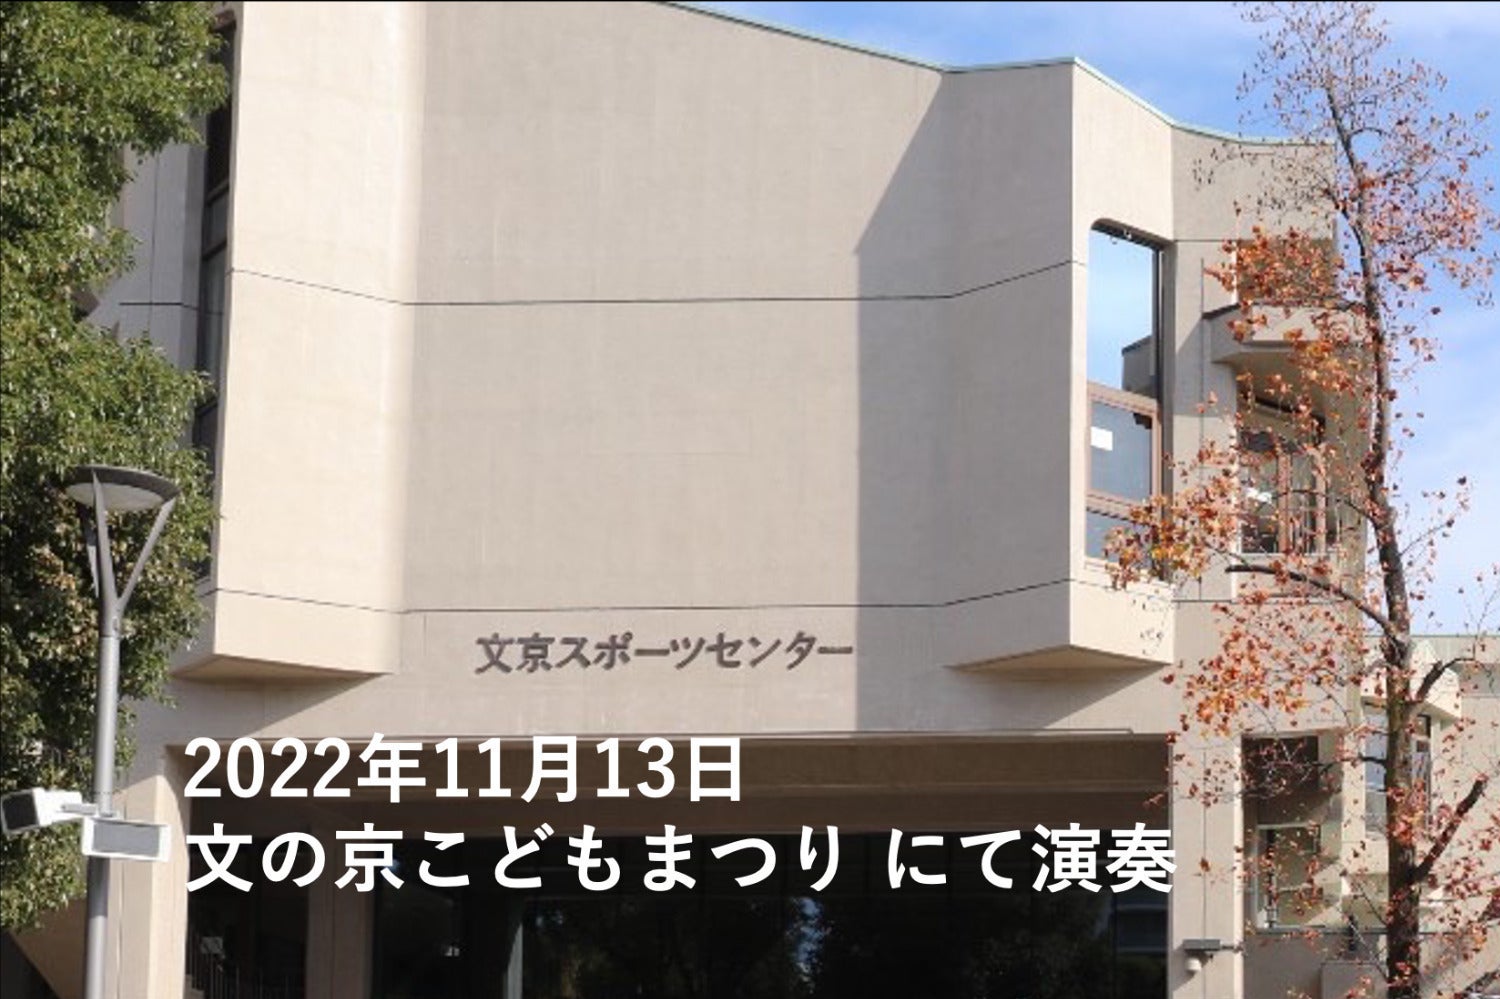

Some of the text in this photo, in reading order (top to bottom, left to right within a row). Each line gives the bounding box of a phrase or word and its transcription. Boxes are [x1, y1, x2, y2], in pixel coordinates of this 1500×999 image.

[475, 631, 853, 674] 文京スポーツセンター
